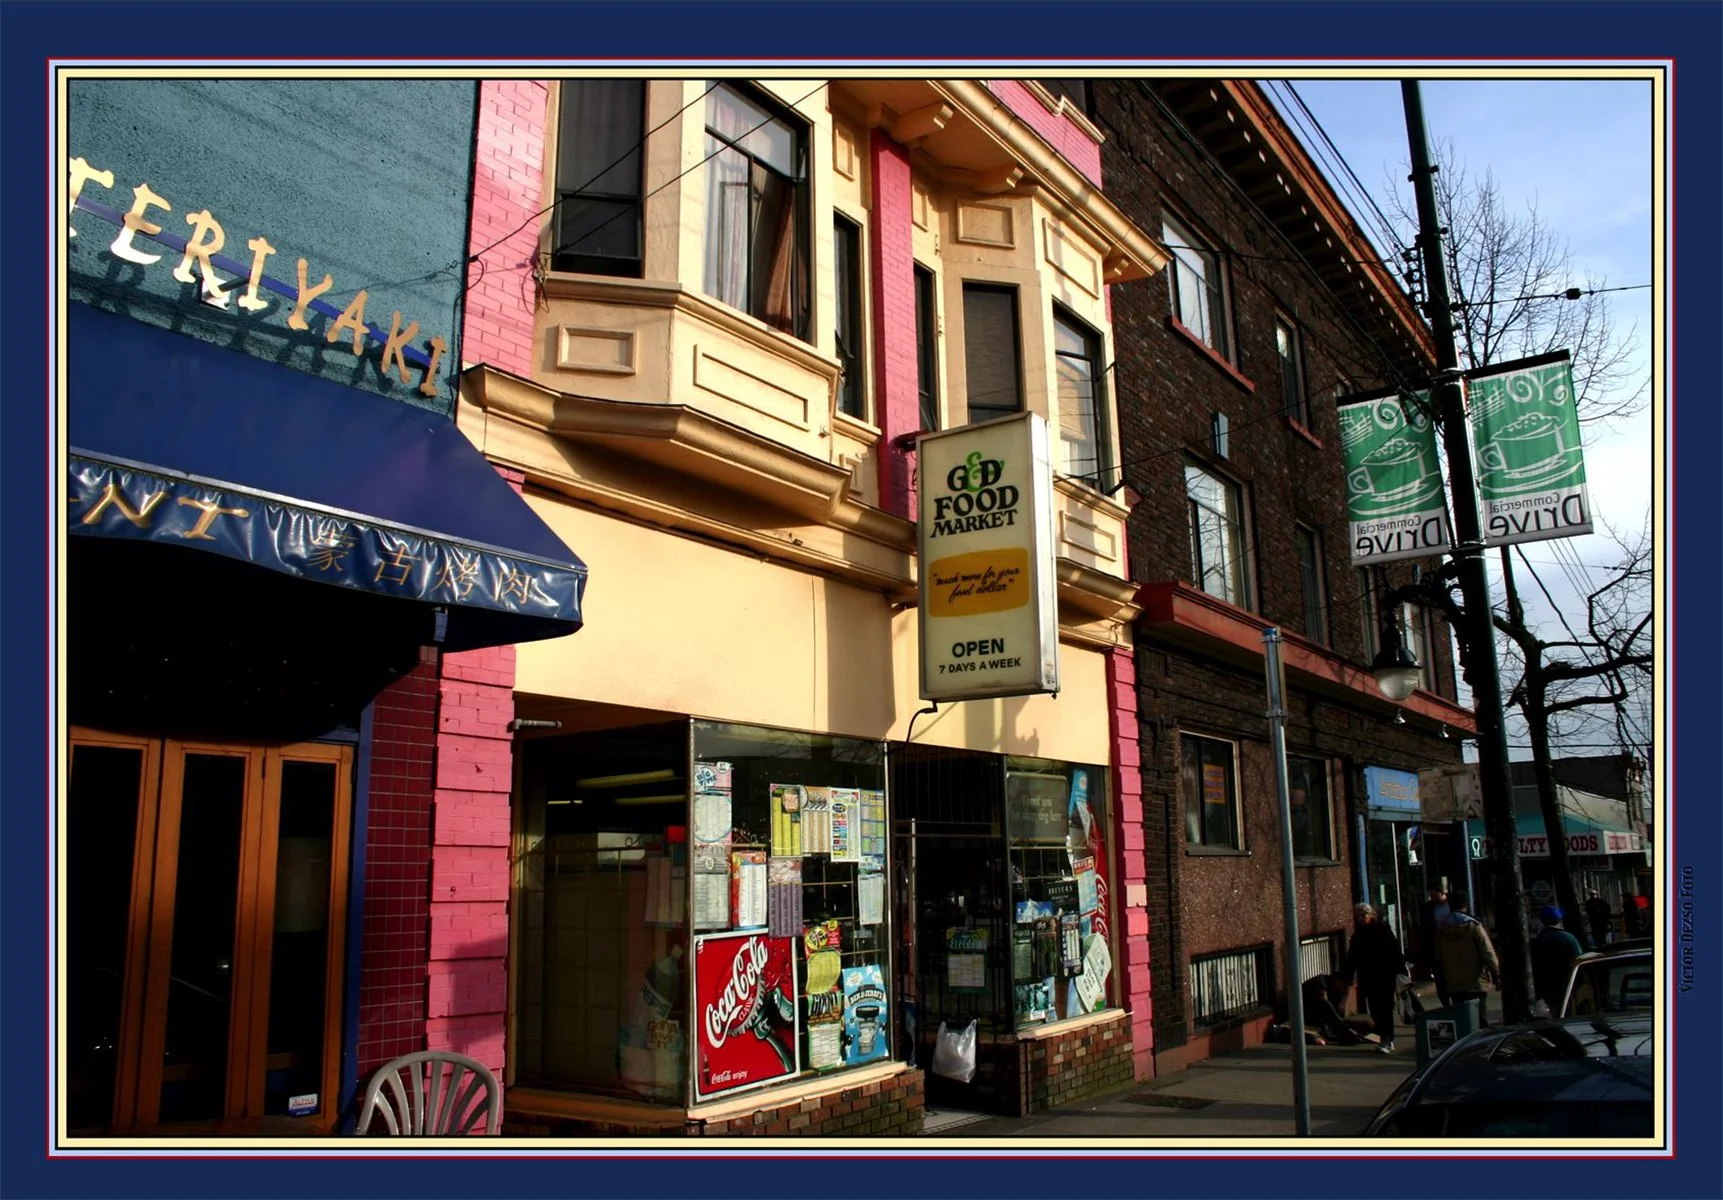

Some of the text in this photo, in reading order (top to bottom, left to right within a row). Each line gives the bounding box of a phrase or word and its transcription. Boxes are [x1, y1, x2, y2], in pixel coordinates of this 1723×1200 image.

[69, 157, 447, 398] TERIYAKI
[947, 451, 1005, 493] G&D
[934, 485, 1019, 520] FOOD
[930, 508, 1018, 538] MARKET
[952, 638, 1005, 658] OPEN
[939, 657, 1022, 674] 7 DAYS A WEEK
